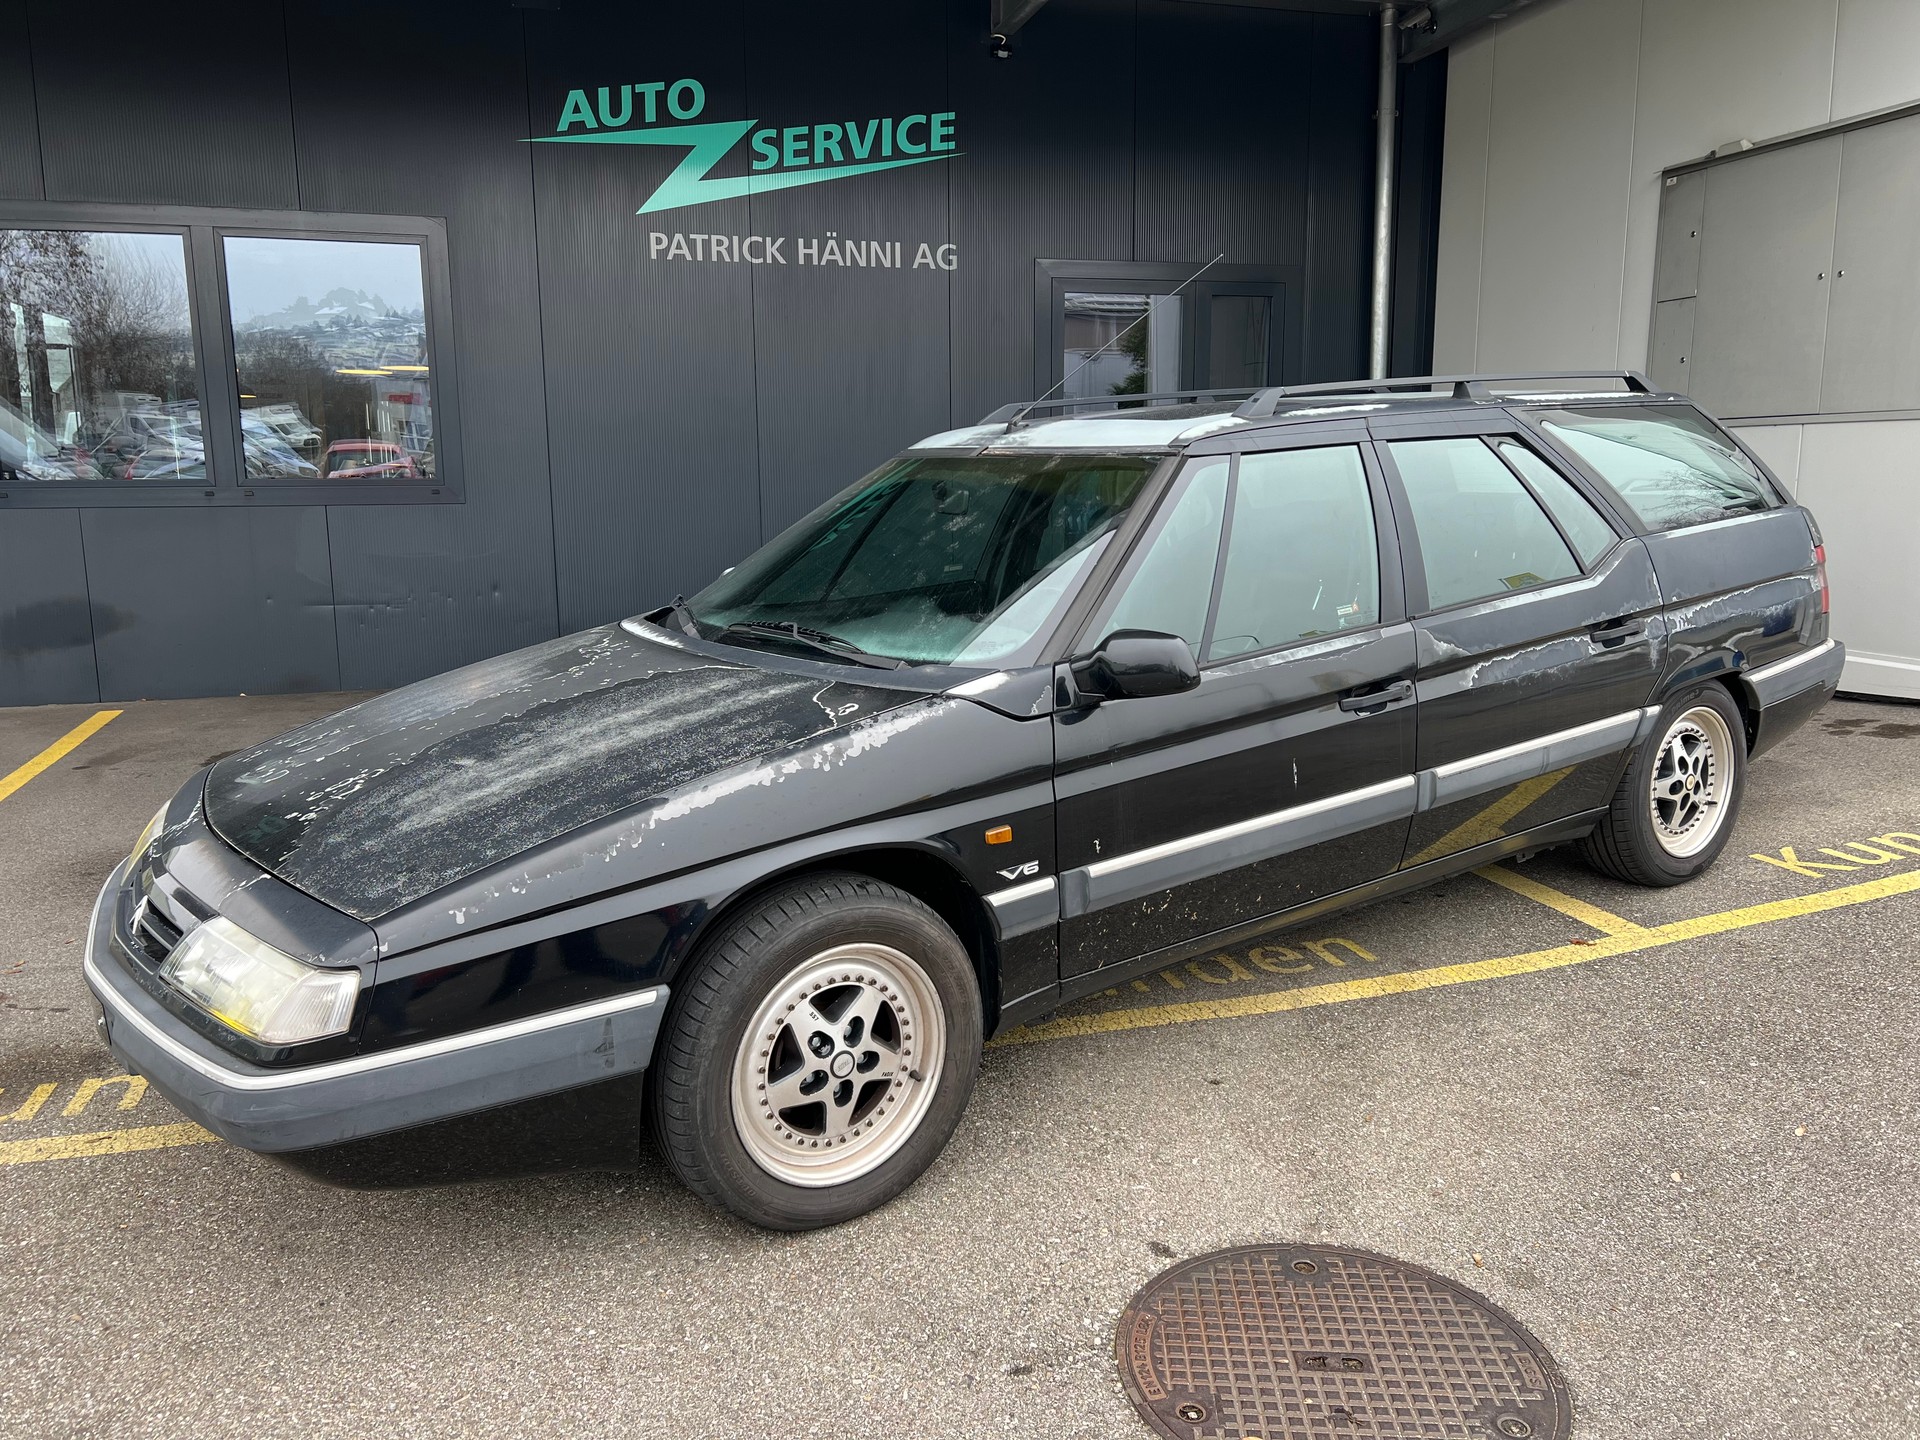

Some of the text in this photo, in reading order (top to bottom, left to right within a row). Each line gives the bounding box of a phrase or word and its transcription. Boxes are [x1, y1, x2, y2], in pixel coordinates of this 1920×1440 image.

[557, 78, 705, 132] AUTO
[751, 111, 956, 170] SERVICE
[650, 231, 958, 271] PATRICK HÄNNI AG
[996, 859, 1040, 881] V6
